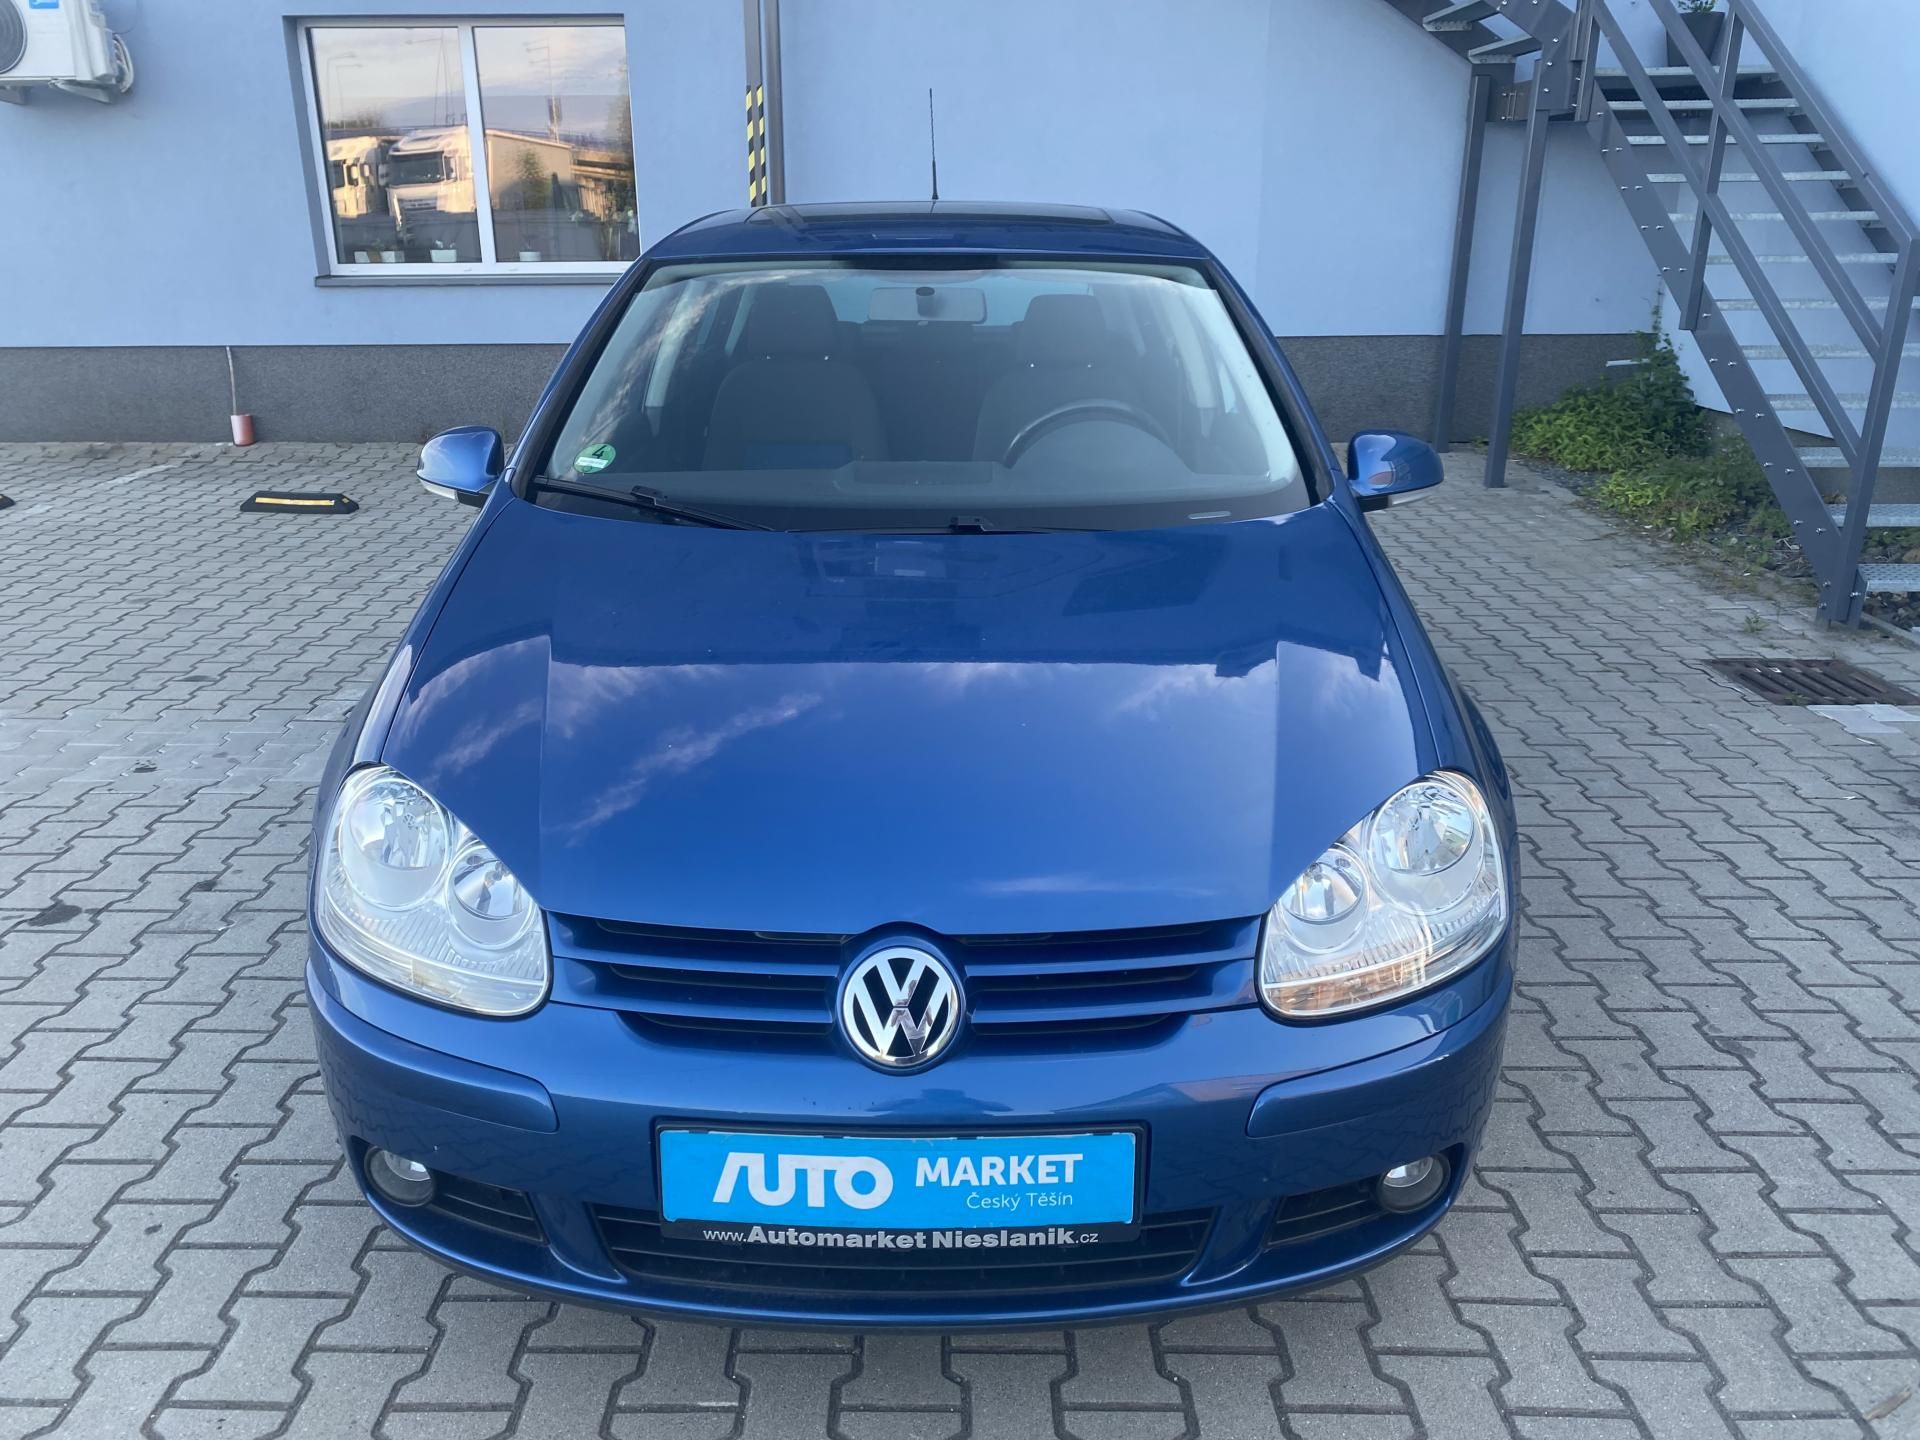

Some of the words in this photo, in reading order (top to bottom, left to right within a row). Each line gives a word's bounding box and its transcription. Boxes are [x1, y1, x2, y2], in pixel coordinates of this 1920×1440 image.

[592, 444, 607, 459] 4
[712, 1151, 894, 1210] AUTO
[915, 1153, 1083, 1187] MARKET
[966, 1191, 1020, 1212] Český
[1026, 1191, 1073, 1208] Těšín
[703, 1225, 927, 1249] www.Automarket
[932, 1227, 1099, 1249] Nieslanik.cz
